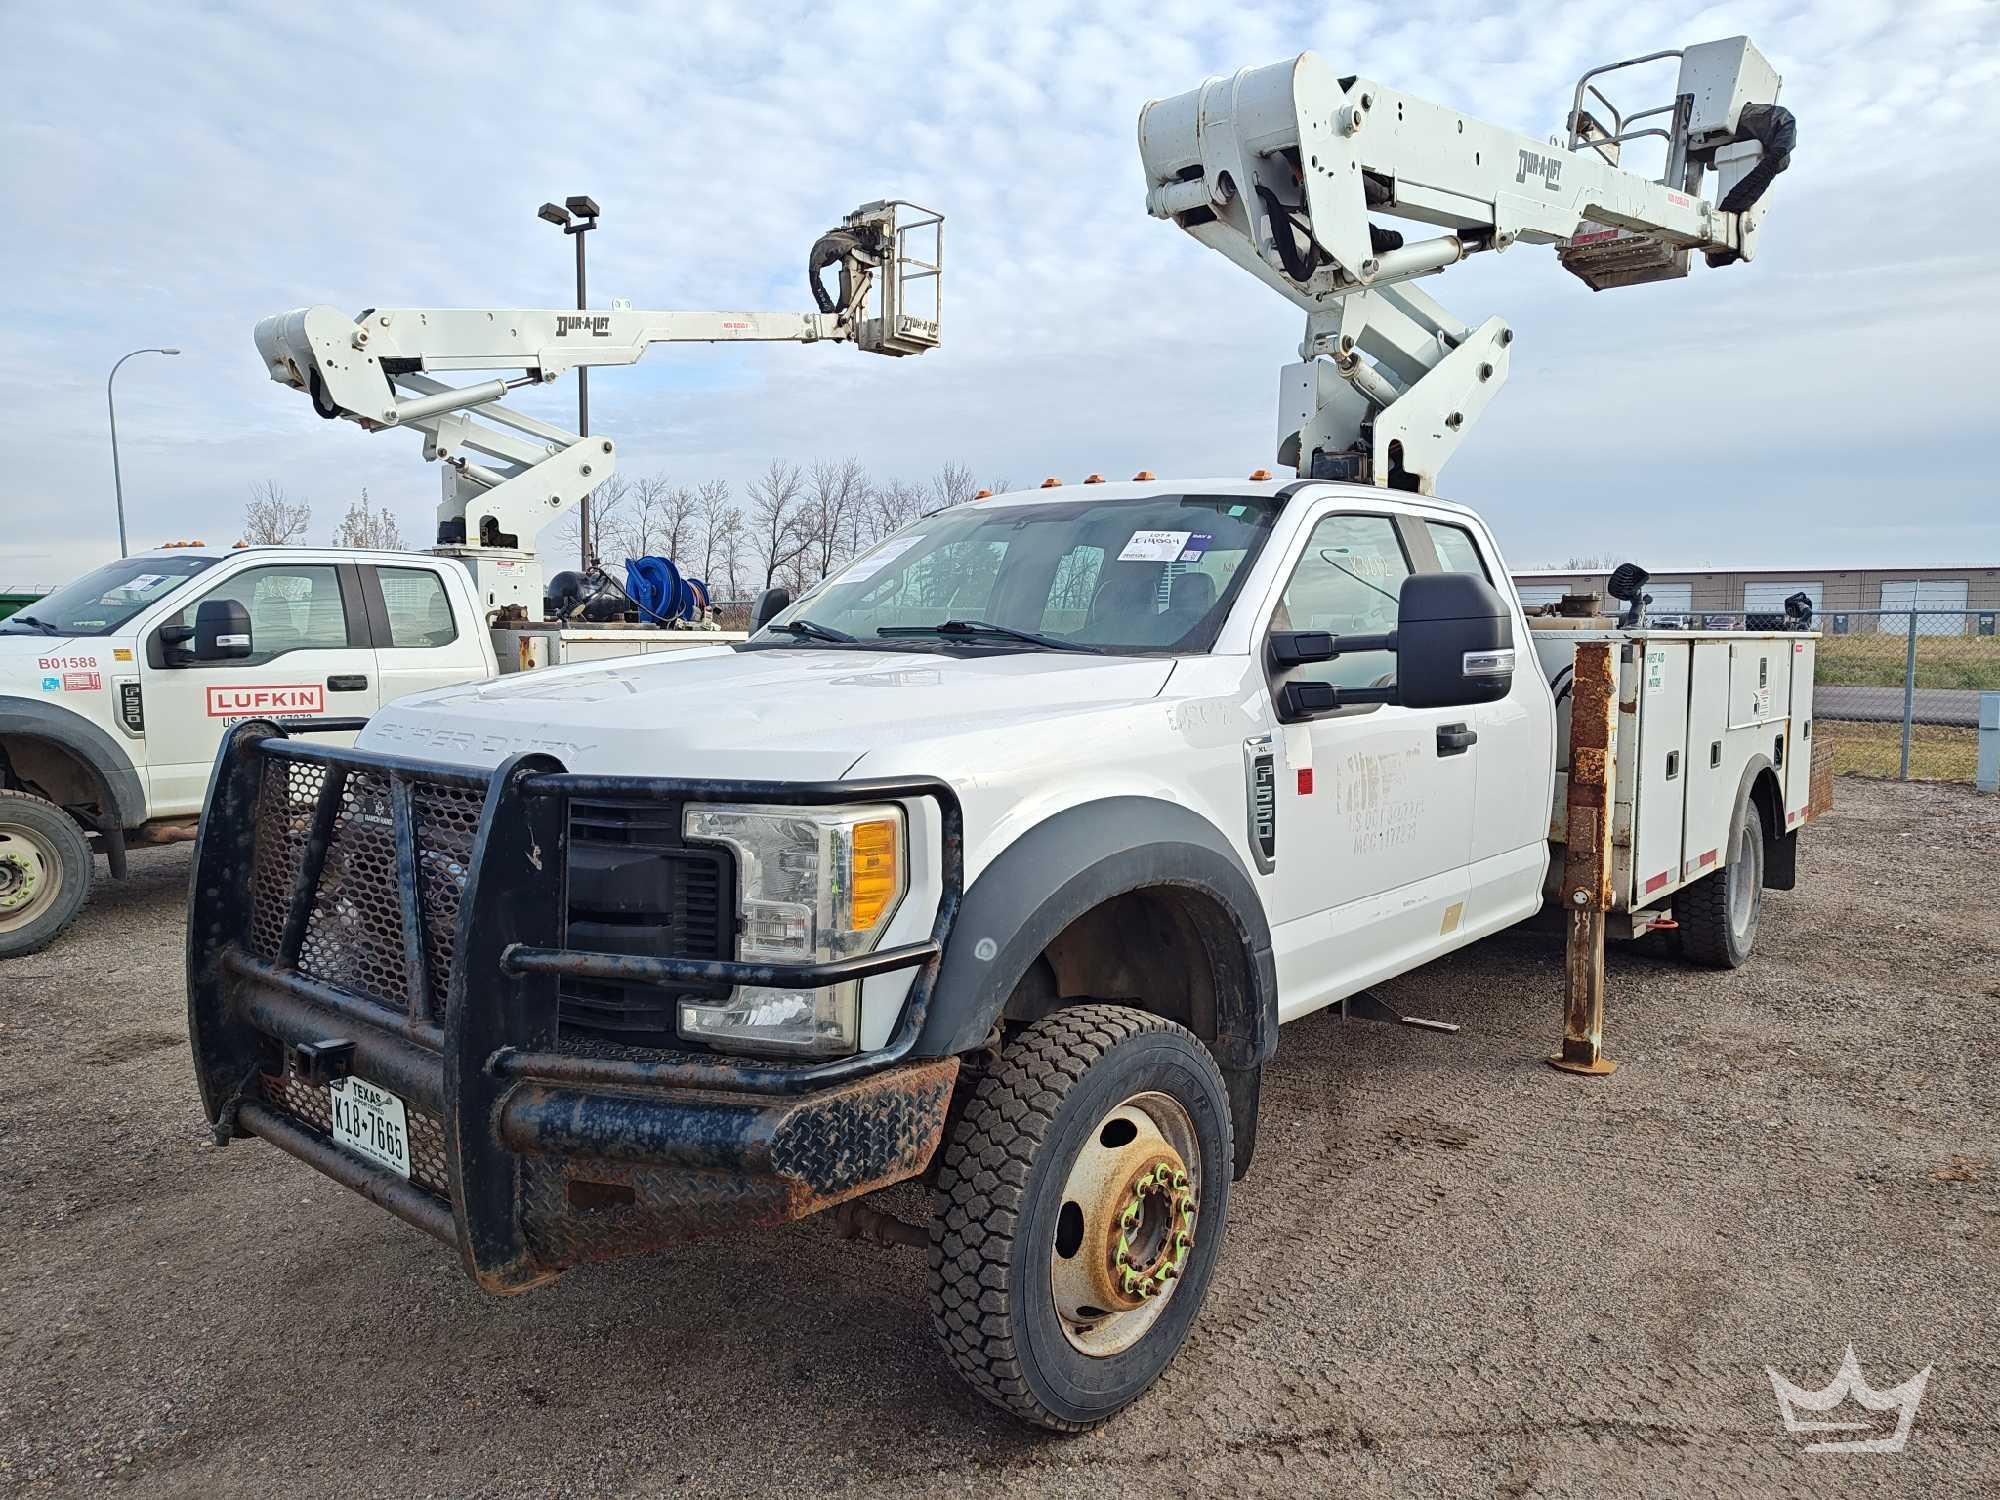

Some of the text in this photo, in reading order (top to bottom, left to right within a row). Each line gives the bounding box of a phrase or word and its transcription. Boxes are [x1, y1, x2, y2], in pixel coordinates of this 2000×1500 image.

[38, 656, 97, 670] B01588
[217, 691, 314, 708] LUFKIN
[353, 1081, 381, 1104] TEXAS
